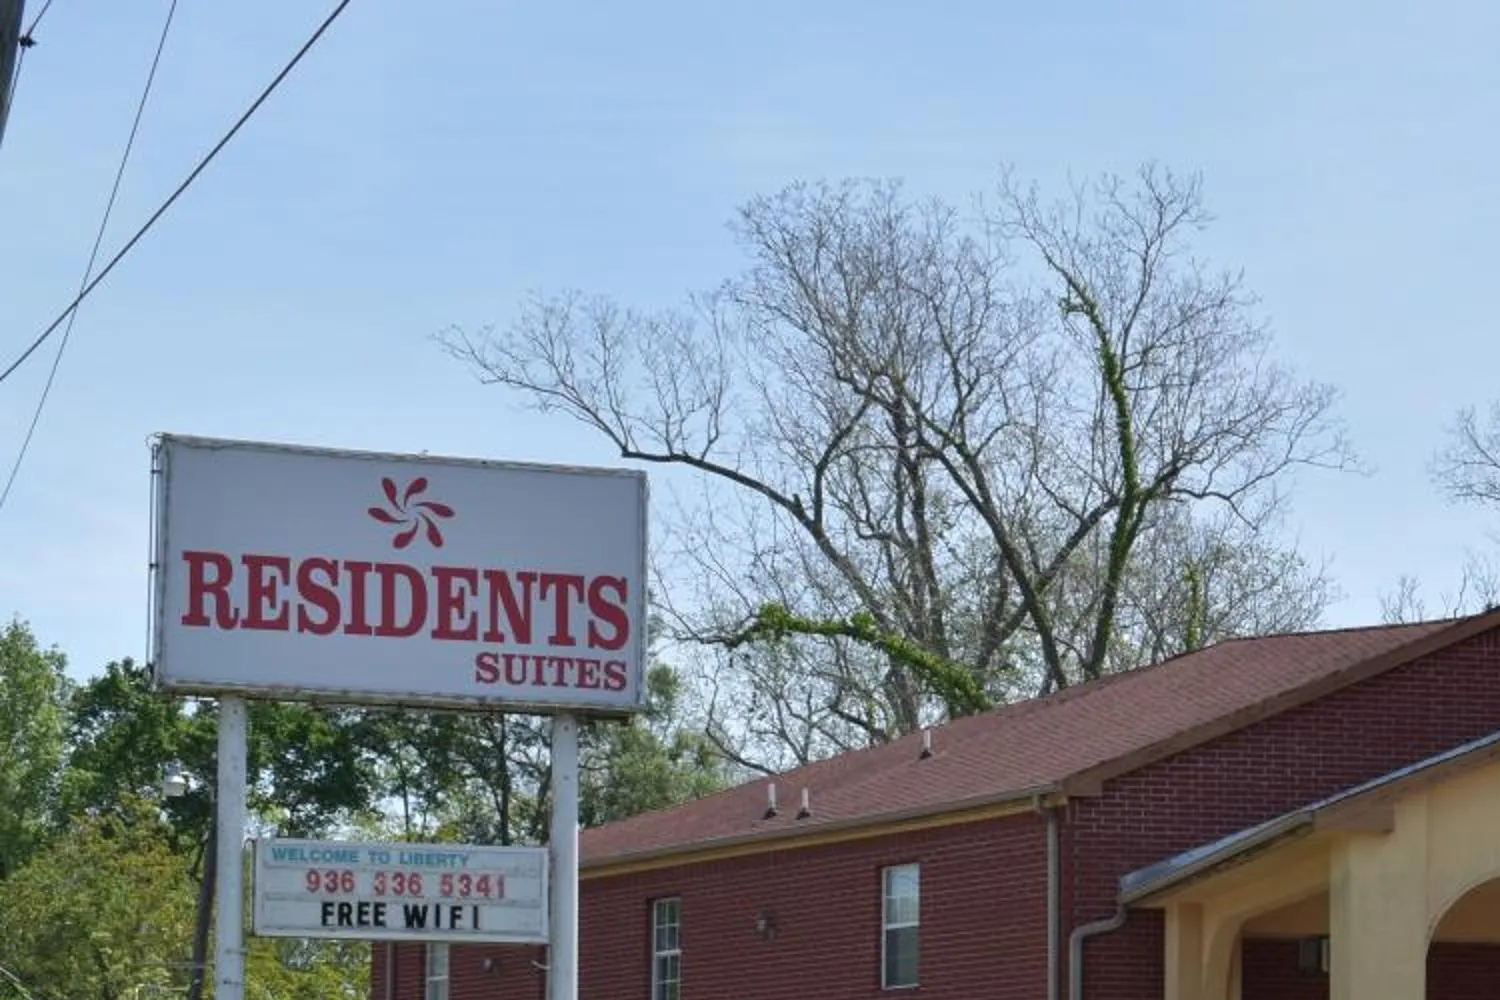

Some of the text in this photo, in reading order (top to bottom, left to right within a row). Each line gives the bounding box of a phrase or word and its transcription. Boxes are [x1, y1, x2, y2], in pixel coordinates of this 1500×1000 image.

[181, 550, 631, 651] RESIDENTS
[475, 652, 628, 692] SUITES
[271, 847, 471, 867] WELCOME TO LIBERTY
[305, 868, 506, 898] 936 336 5341
[321, 901, 481, 930] FREE WIFI
